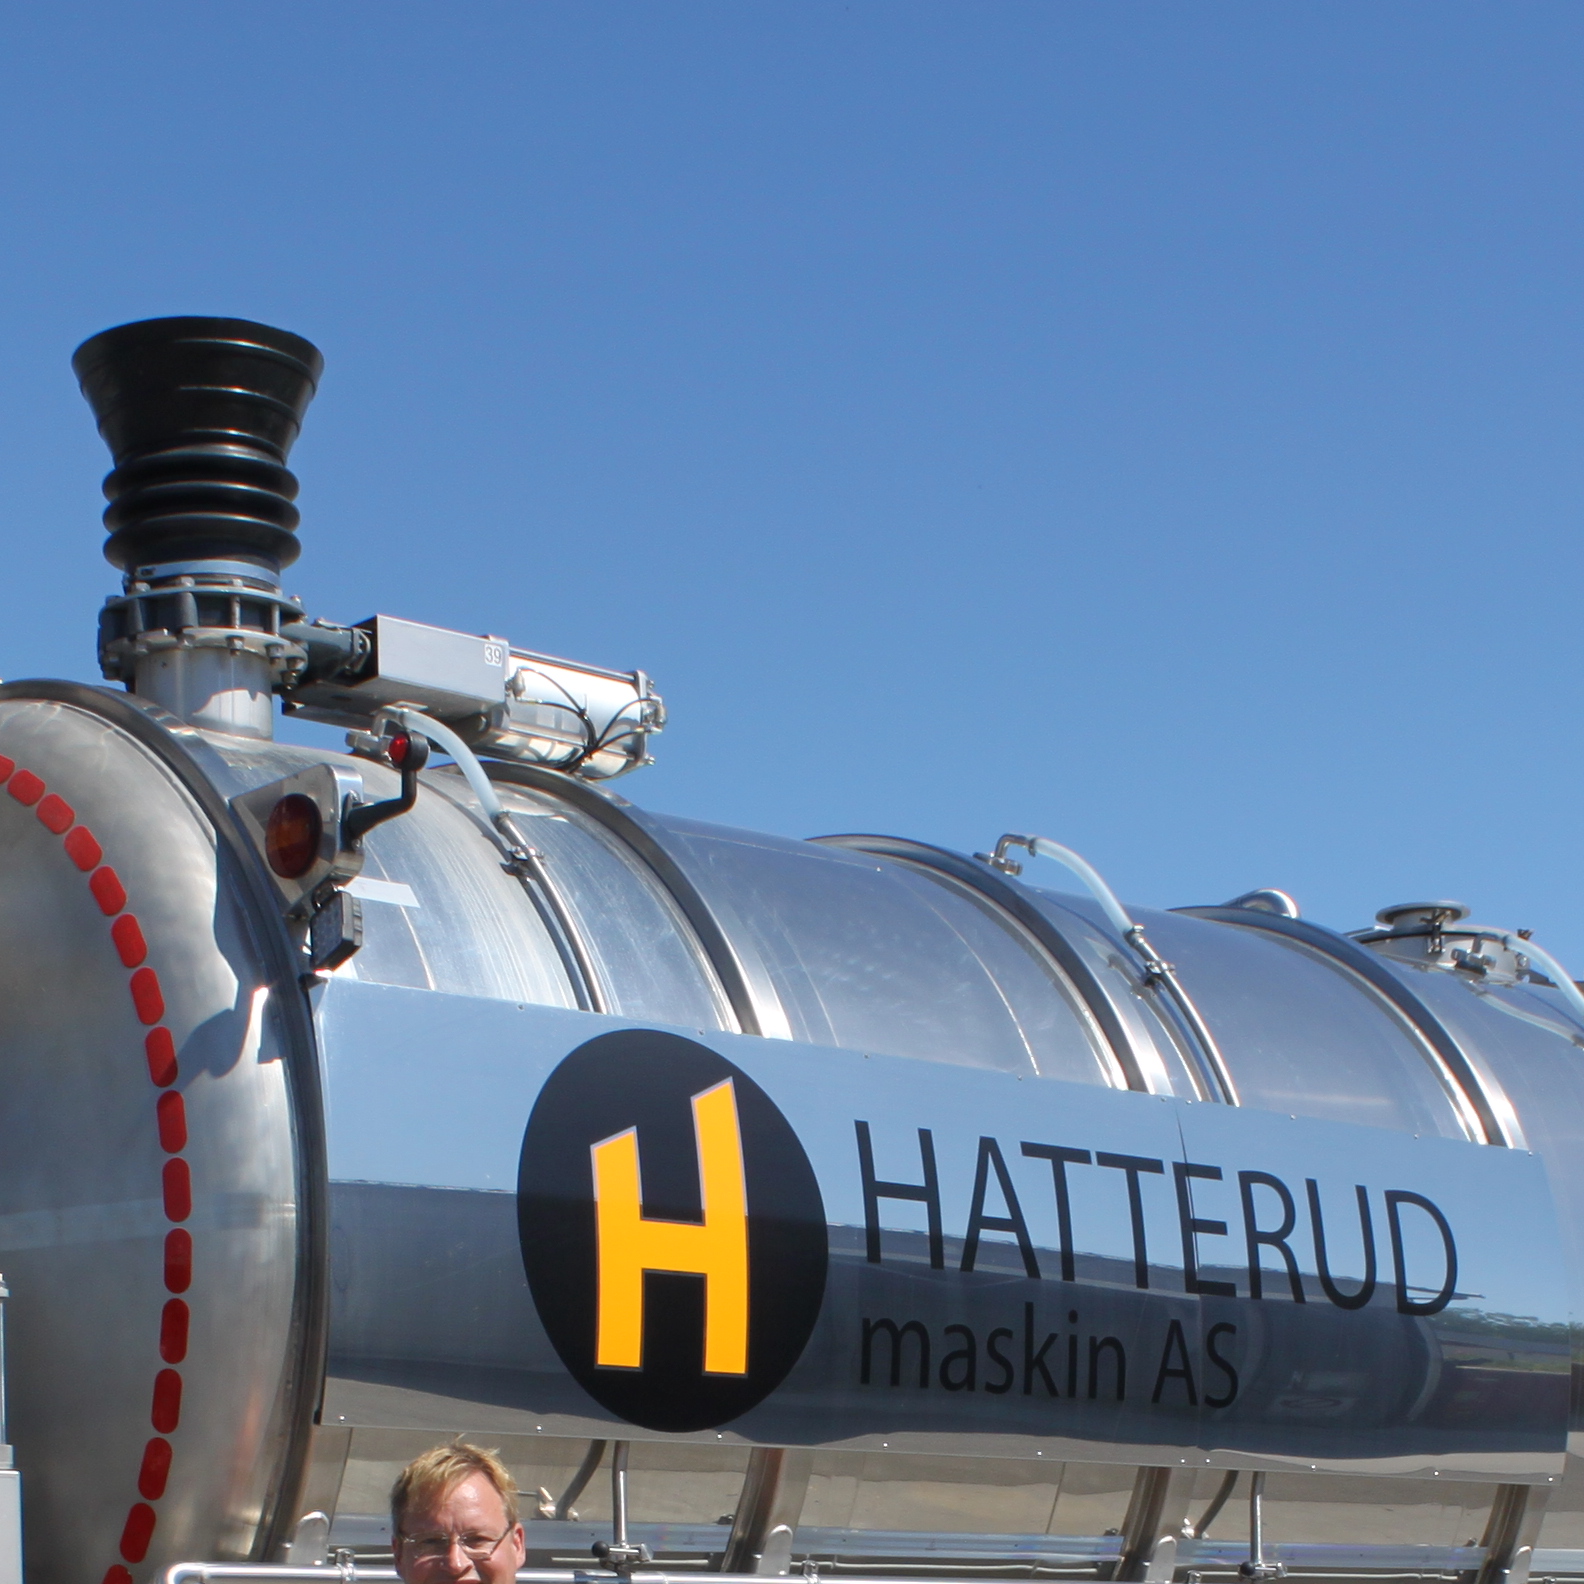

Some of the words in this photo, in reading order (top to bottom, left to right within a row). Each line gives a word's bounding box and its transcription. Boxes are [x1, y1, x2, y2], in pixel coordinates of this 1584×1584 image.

[484, 645, 503, 665] 39
[853, 1120, 1460, 1317] HATTERUD
[859, 1300, 1128, 1403] maskin
[1150, 1321, 1241, 1410] AS
